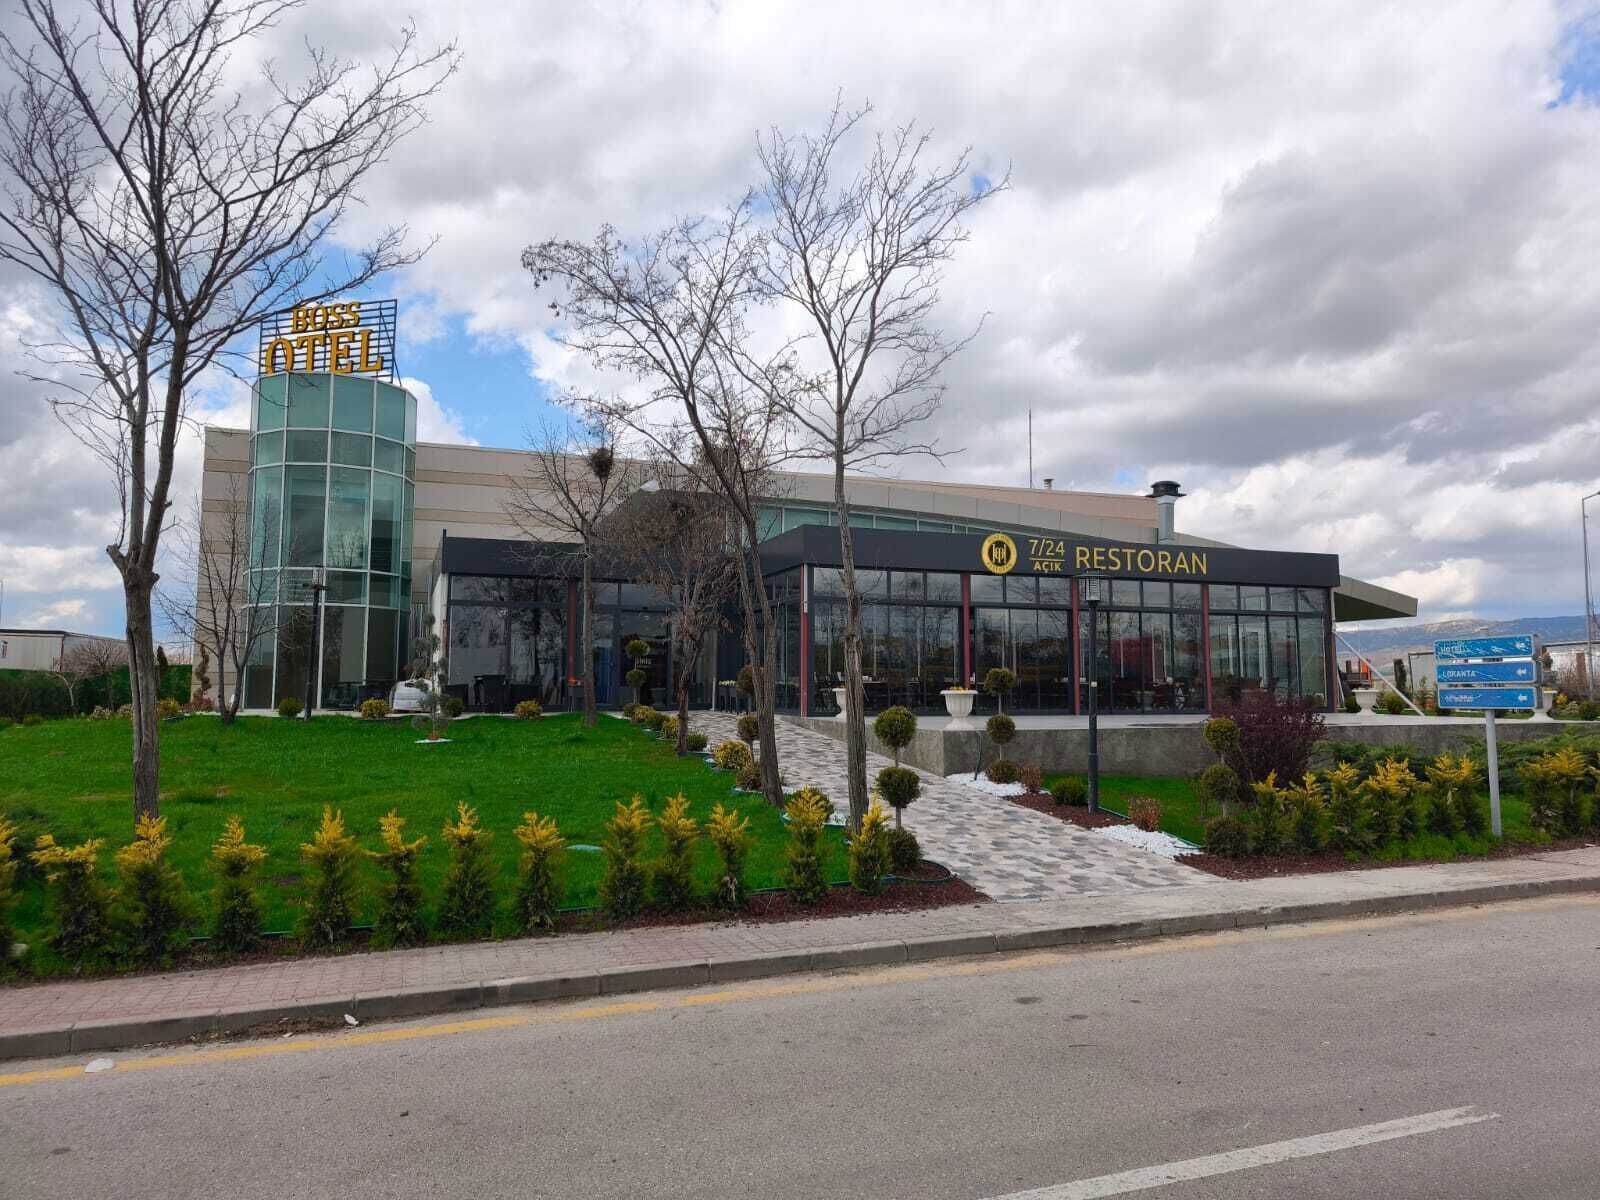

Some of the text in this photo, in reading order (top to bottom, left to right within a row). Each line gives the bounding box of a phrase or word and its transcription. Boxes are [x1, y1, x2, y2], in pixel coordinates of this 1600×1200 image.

[291, 302, 360, 333] BOSS
[265, 329, 384, 374] OTEL
[1028, 539, 1065, 556] 7/24
[1075, 546, 1208, 575] RESTORAN
[1033, 561, 1062, 573] AÇIK
